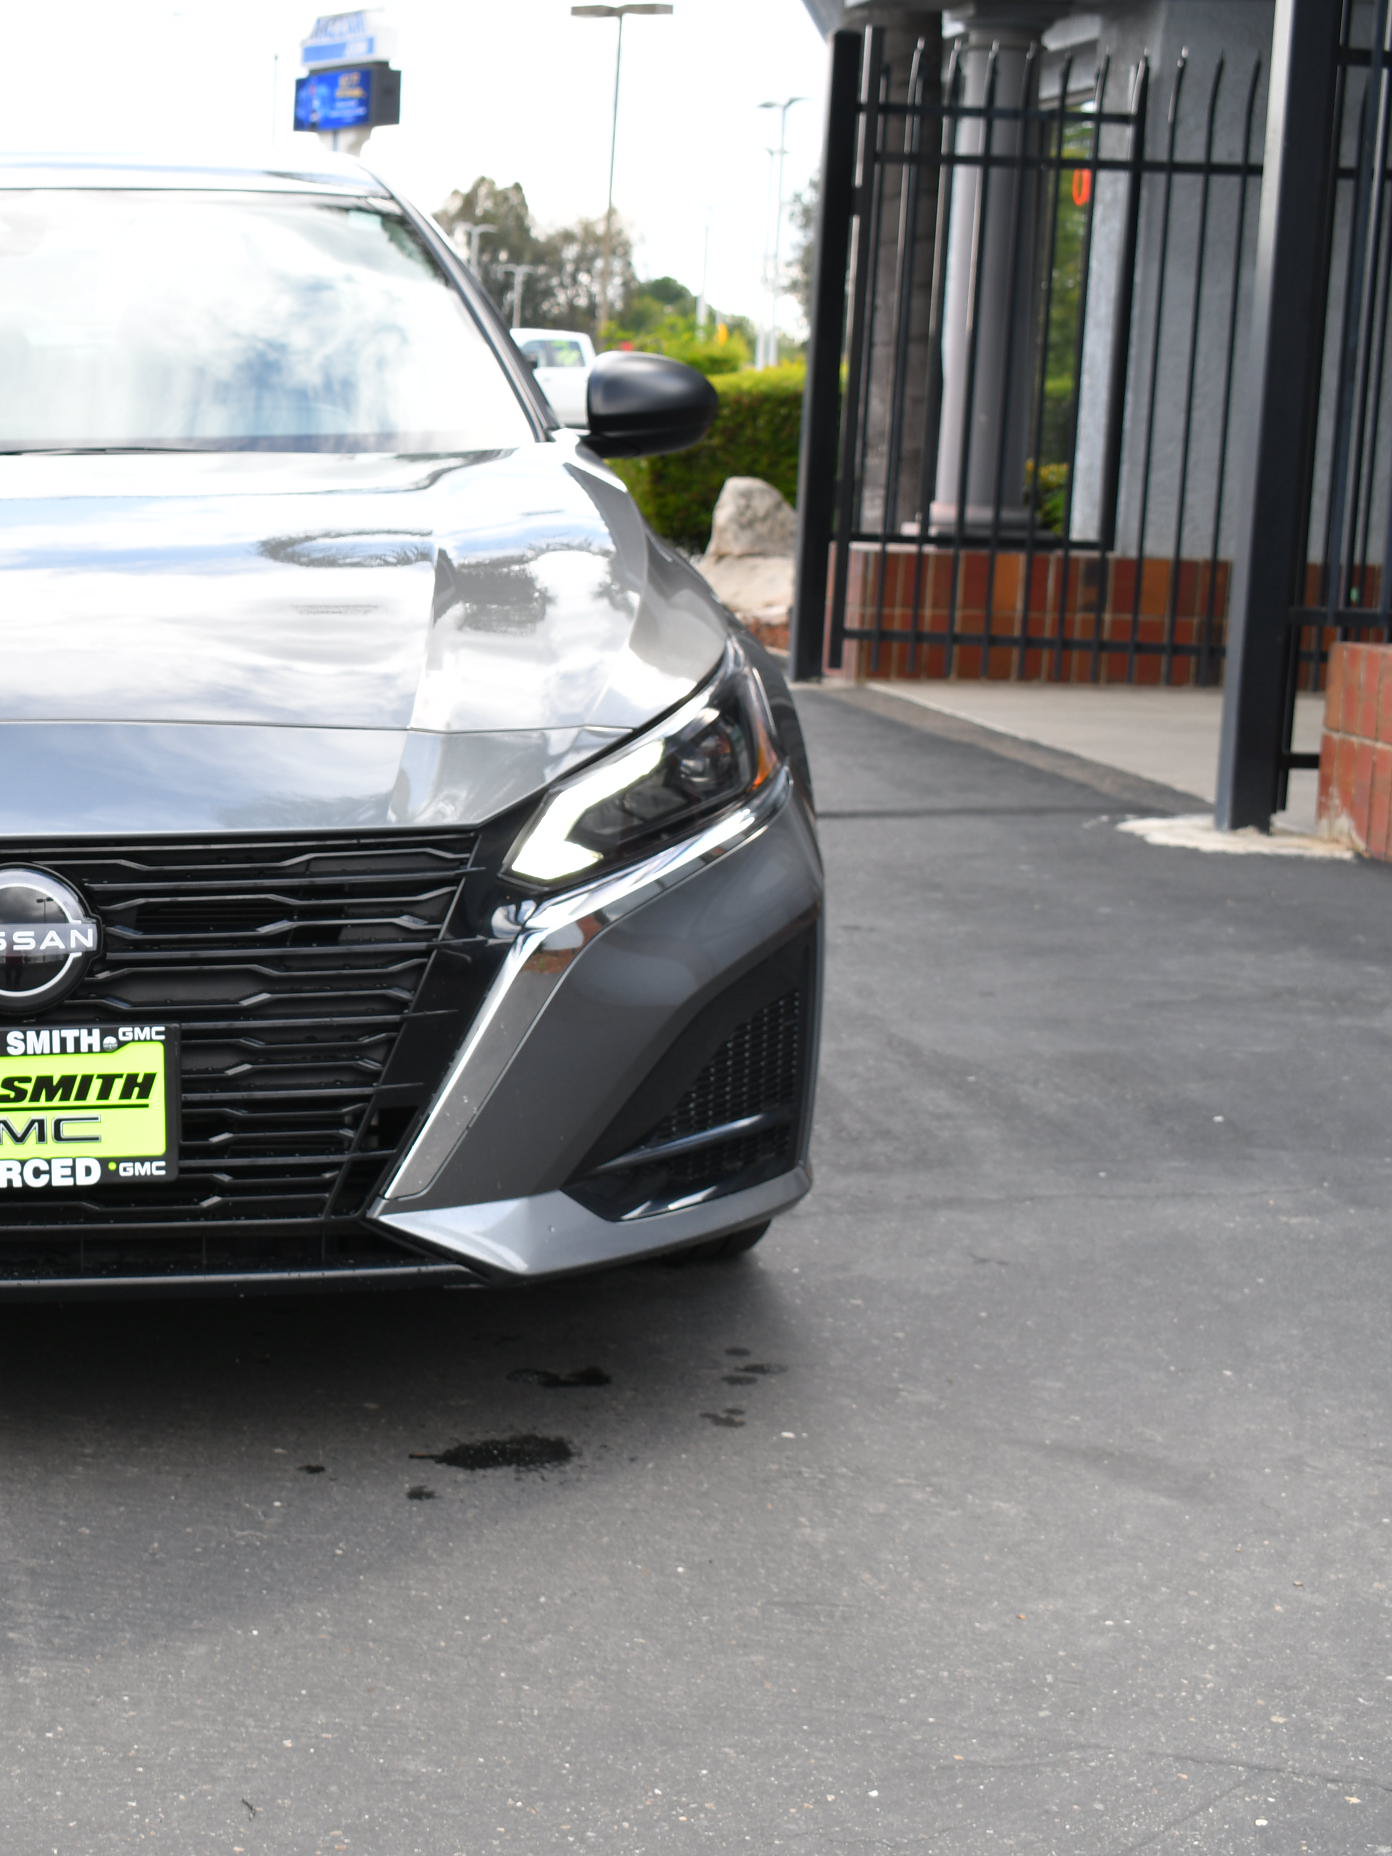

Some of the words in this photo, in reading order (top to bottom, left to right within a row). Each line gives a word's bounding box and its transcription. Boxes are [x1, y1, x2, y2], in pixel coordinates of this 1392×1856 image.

[6, 1028, 101, 1056] SMITH
[118, 1026, 166, 1041] GMC
[118, 1161, 167, 1177] GMC
